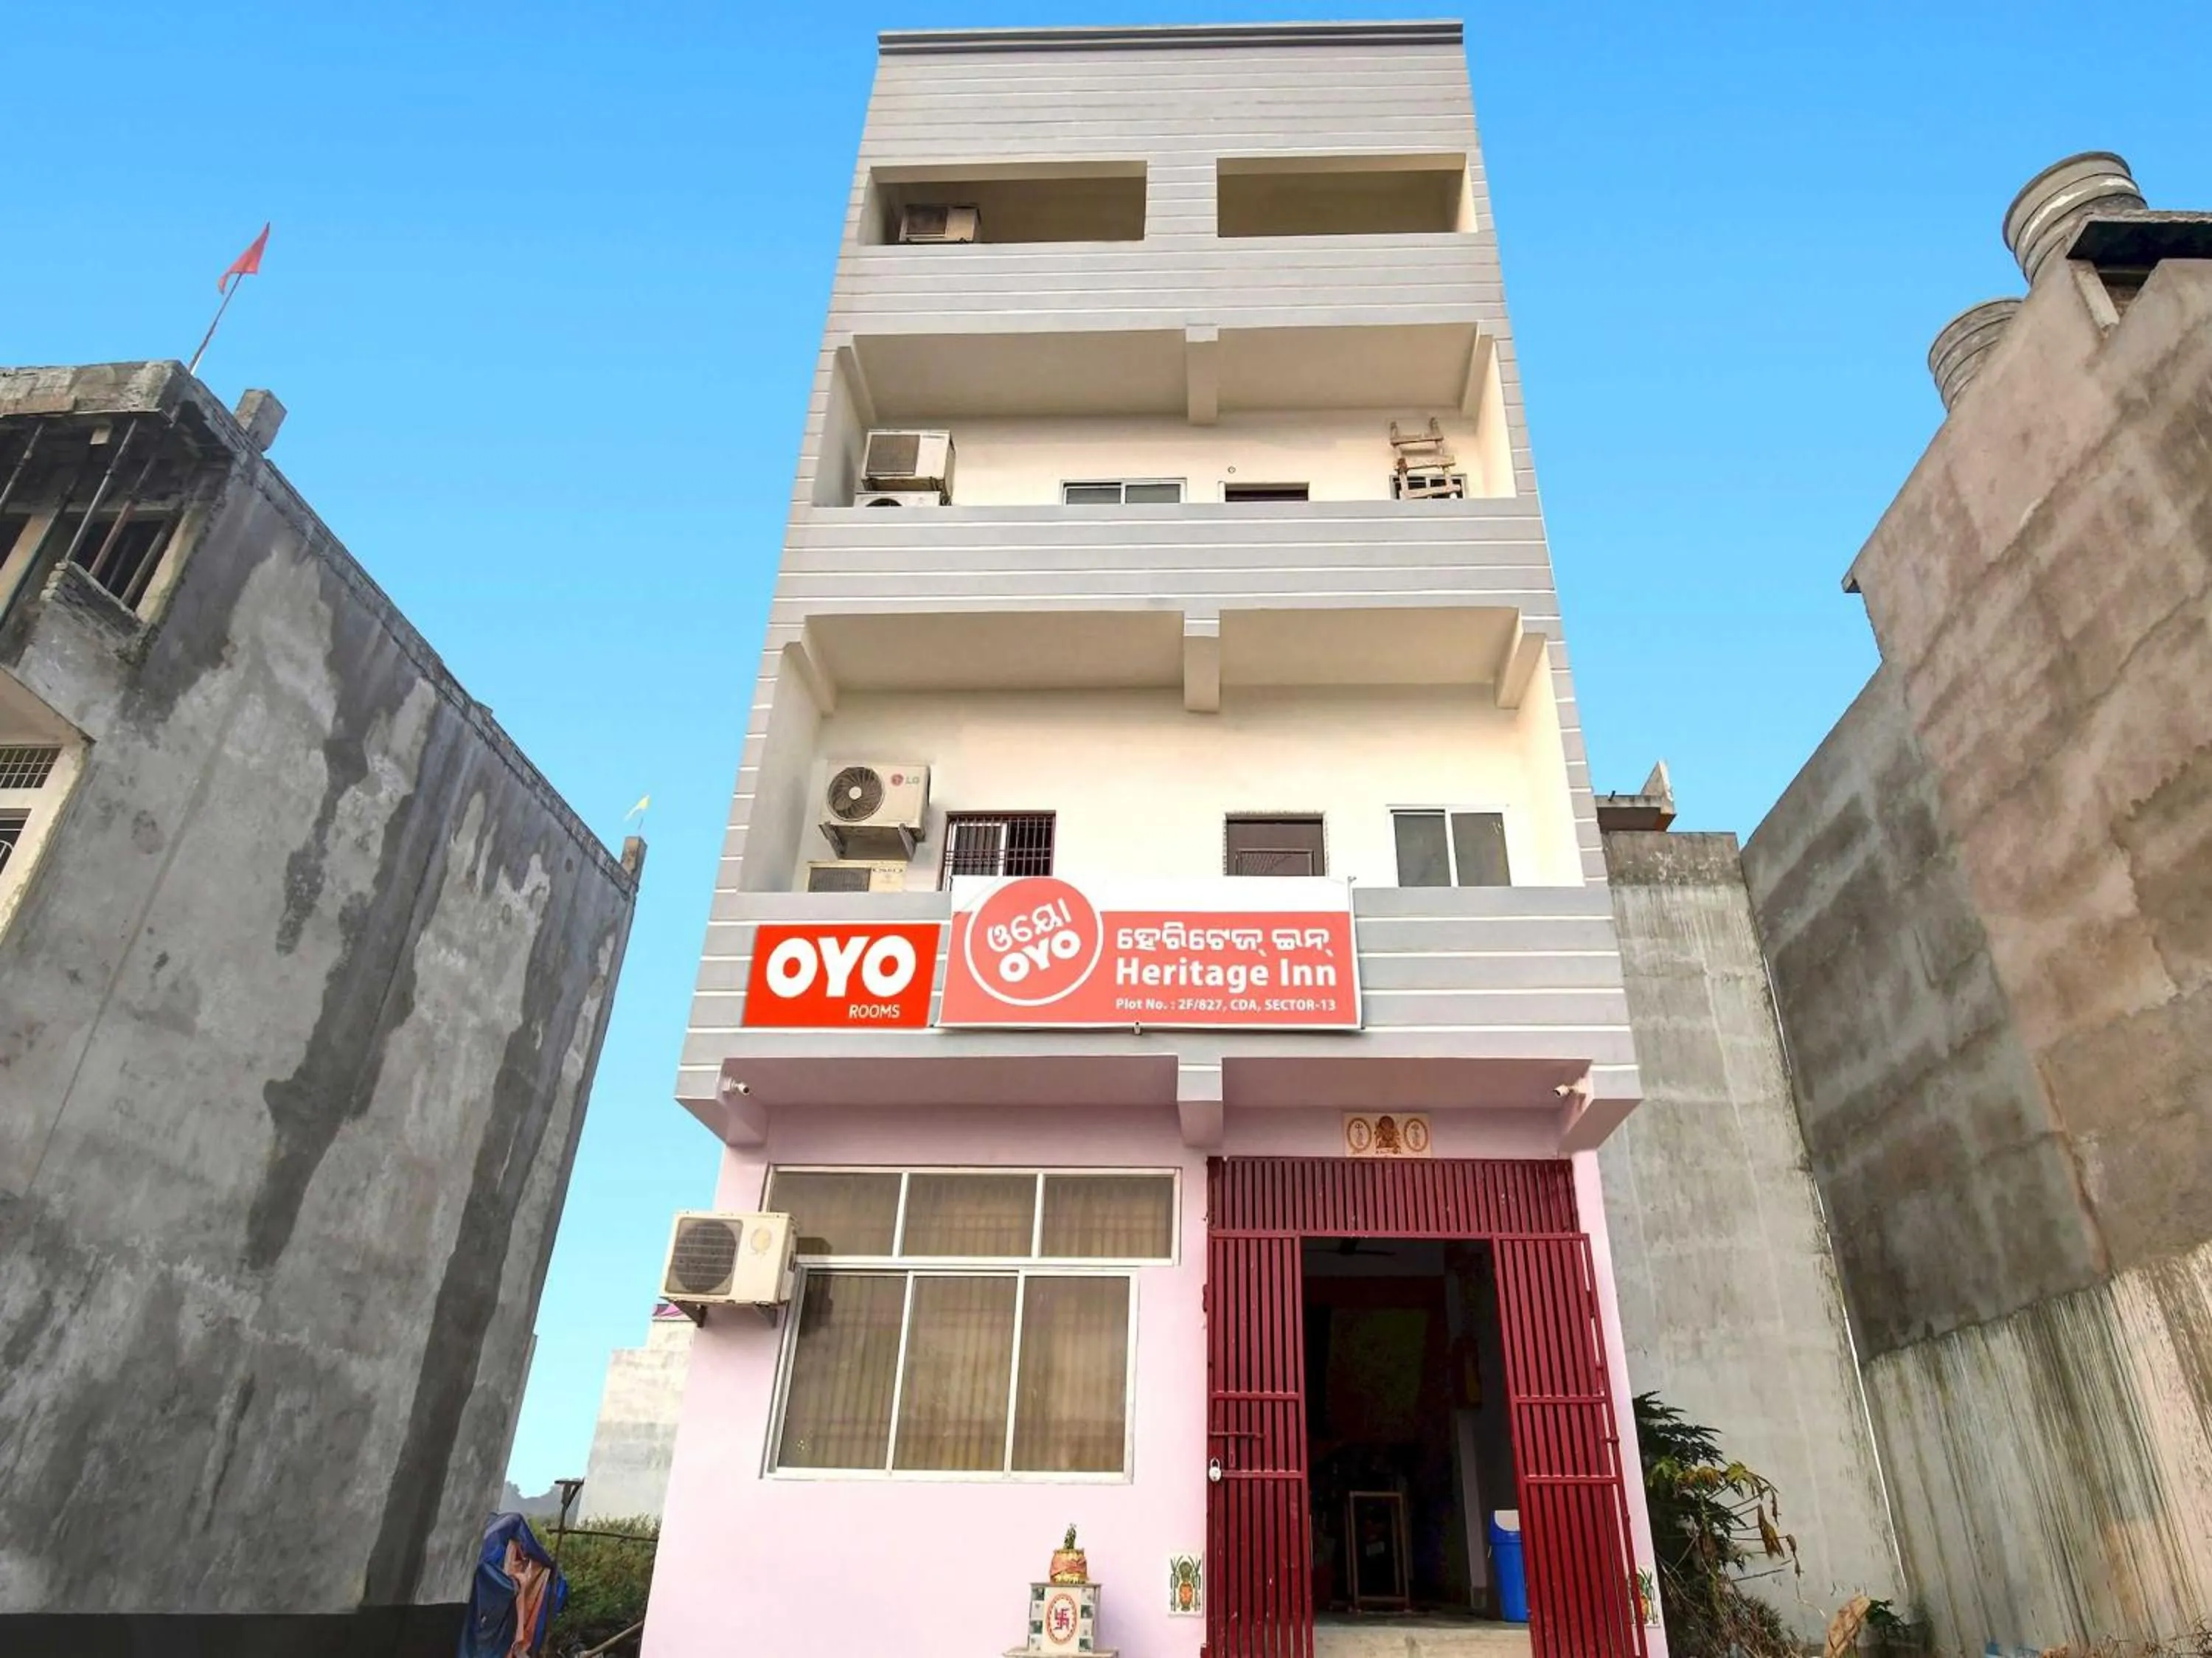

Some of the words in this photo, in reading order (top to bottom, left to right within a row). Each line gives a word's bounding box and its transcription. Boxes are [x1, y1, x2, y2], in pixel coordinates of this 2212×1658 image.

[765, 934, 917, 999] OYO
[998, 929, 1082, 982] OYO
[1116, 957, 1269, 994] Heritage
[1279, 958, 1336, 987] Inn
[849, 1004, 900, 1019] ROOMS
[1115, 998, 1142, 1010] Plot
[1145, 998, 1167, 1010] No.
[1178, 998, 1228, 1013] 2F/827,
[1230, 999, 1262, 1013] CDA,
[1264, 999, 1337, 1012] SECTOR-13
